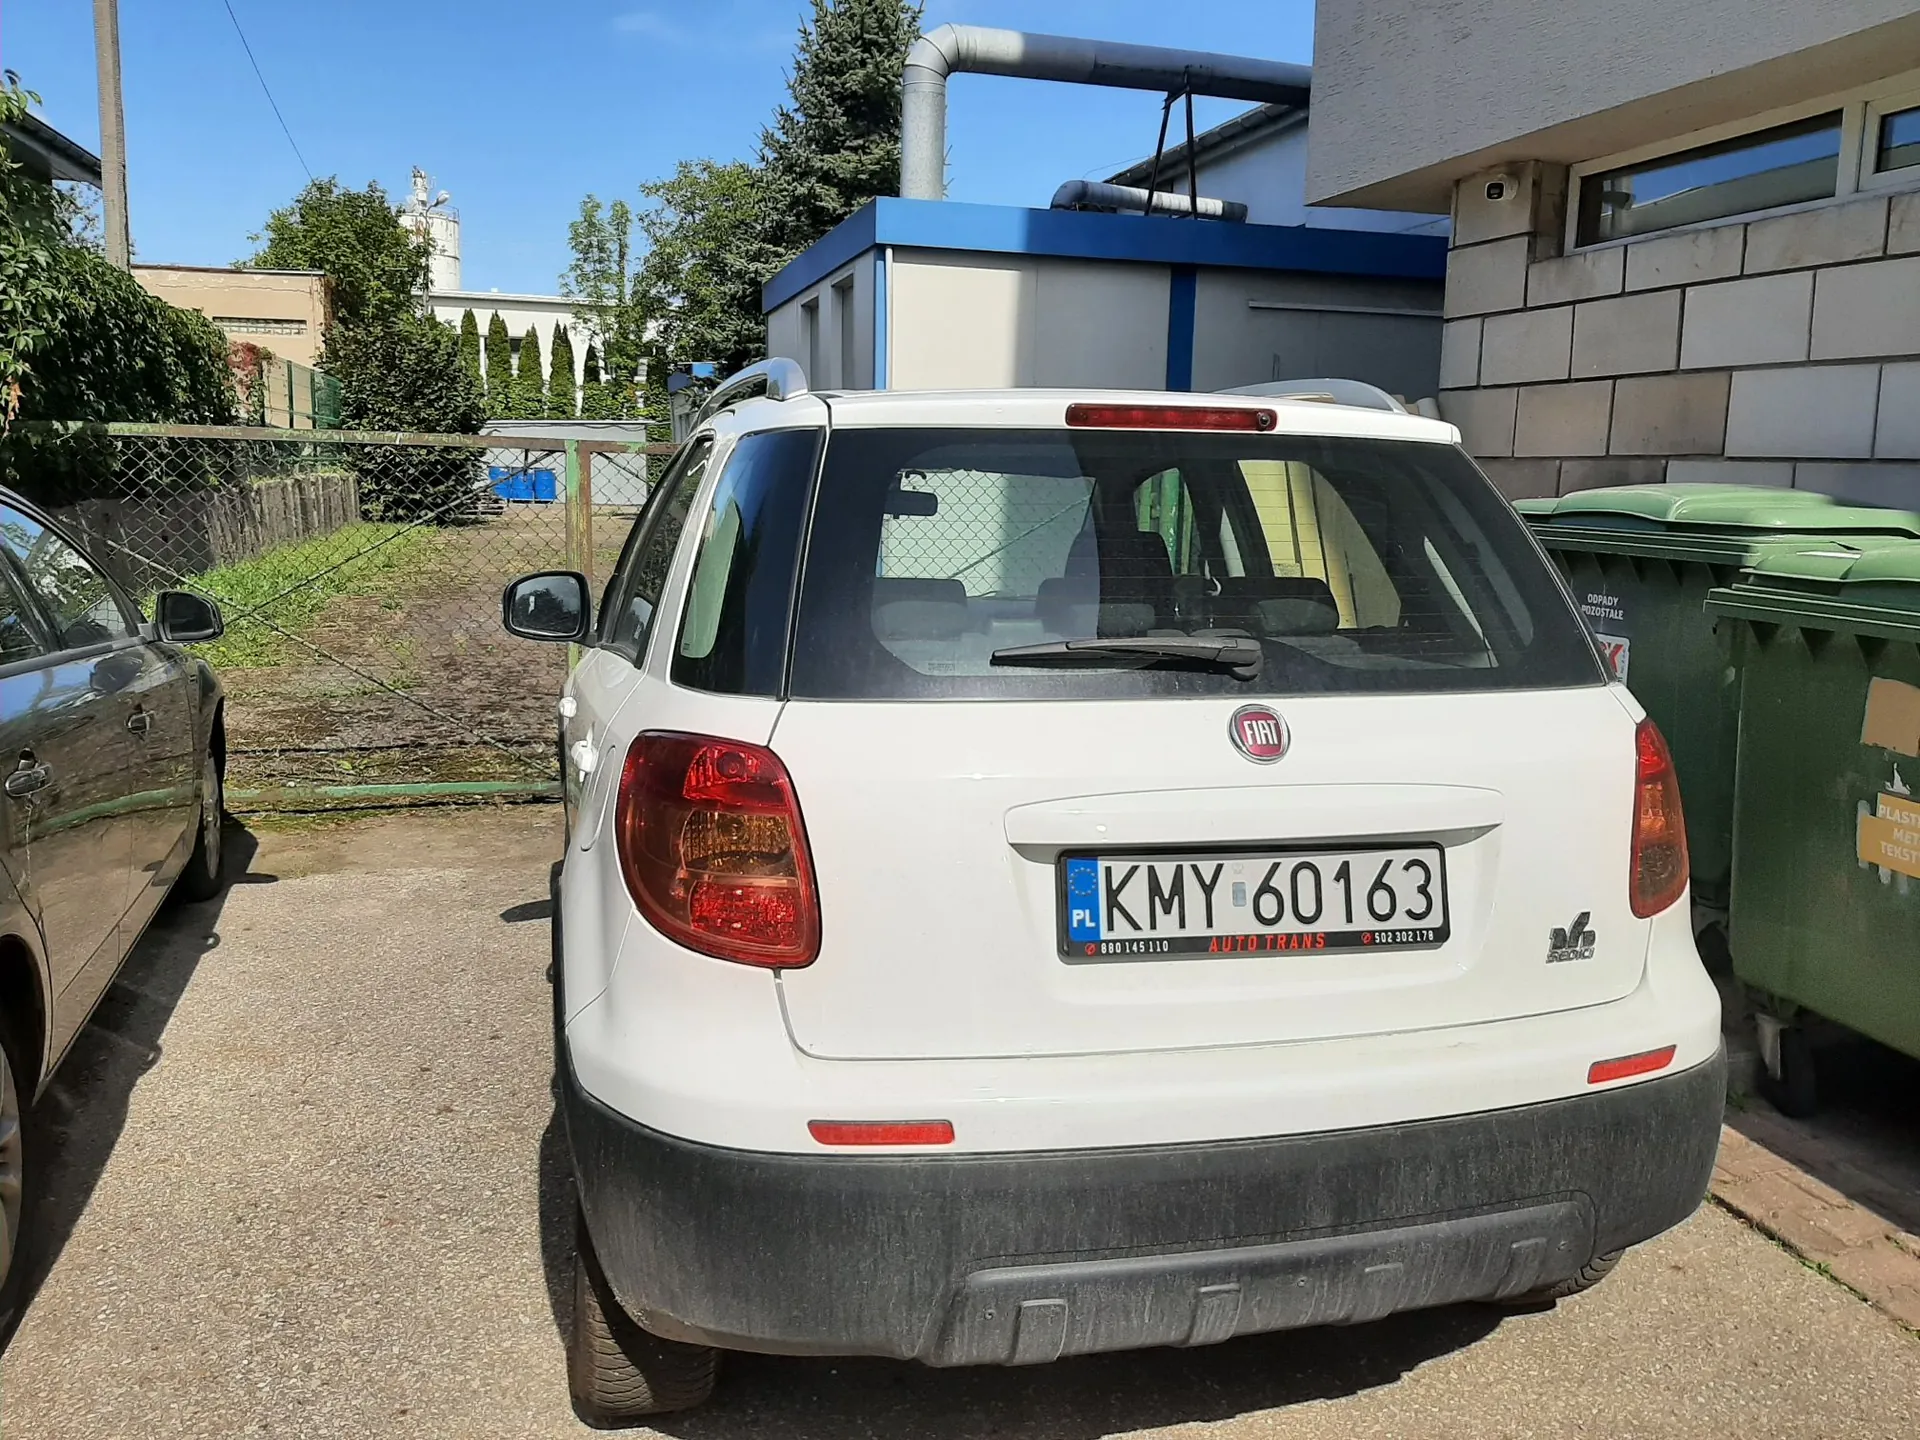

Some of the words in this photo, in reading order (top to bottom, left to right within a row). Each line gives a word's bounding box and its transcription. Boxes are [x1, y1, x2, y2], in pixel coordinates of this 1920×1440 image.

[1587, 593, 1619, 606] ODPADY
[1243, 719, 1279, 746] FIAT
[1893, 827, 1920, 846] MET
[1880, 840, 1920, 865] TEKST
[1104, 863, 1225, 932] KMY
[1252, 858, 1433, 926] 60163
[1072, 908, 1096, 928] PL
[1208, 935, 1258, 953] AUTO
[1265, 932, 1326, 950] TRANS
